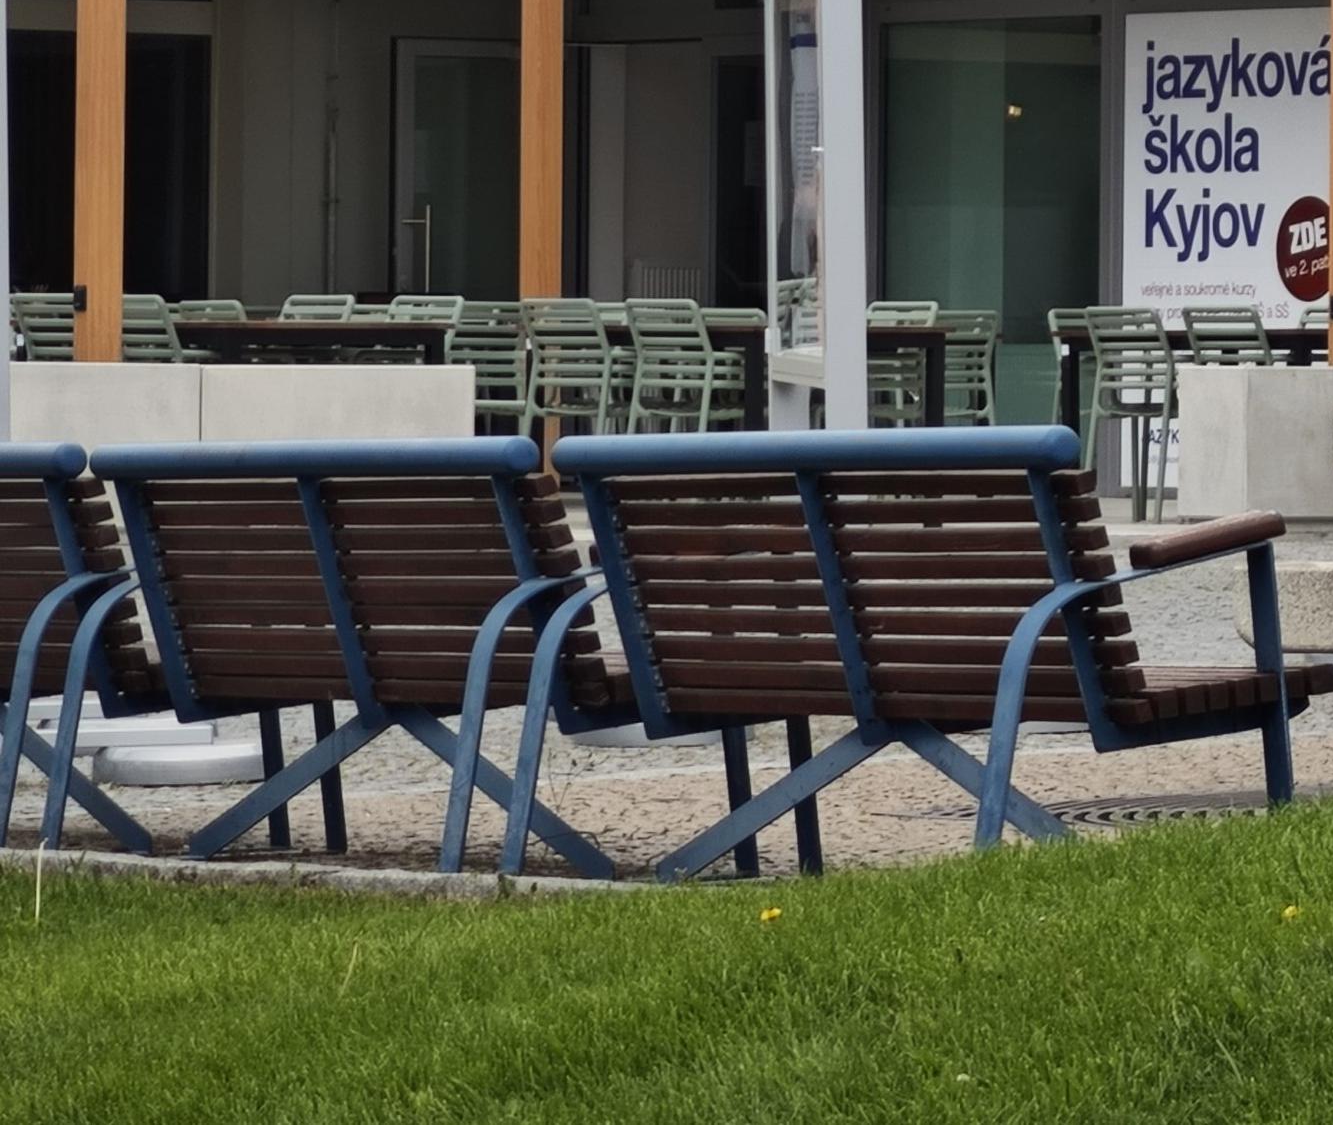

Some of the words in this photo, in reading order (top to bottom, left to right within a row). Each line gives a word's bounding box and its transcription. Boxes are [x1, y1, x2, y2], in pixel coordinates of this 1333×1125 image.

[1142, 34, 1332, 114] jazyková
[1144, 112, 1260, 174] škola
[1144, 187, 1266, 263] Kyjov
[1288, 216, 1328, 255] ZDE
[1140, 282, 1174, 299] veřejné
[1175, 286, 1182, 296] a
[1184, 282, 1230, 296] soukromé
[1232, 282, 1256, 299] kurzy
[1284, 265, 1298, 278] ve
[1275, 301, 1289, 319] SŠ
